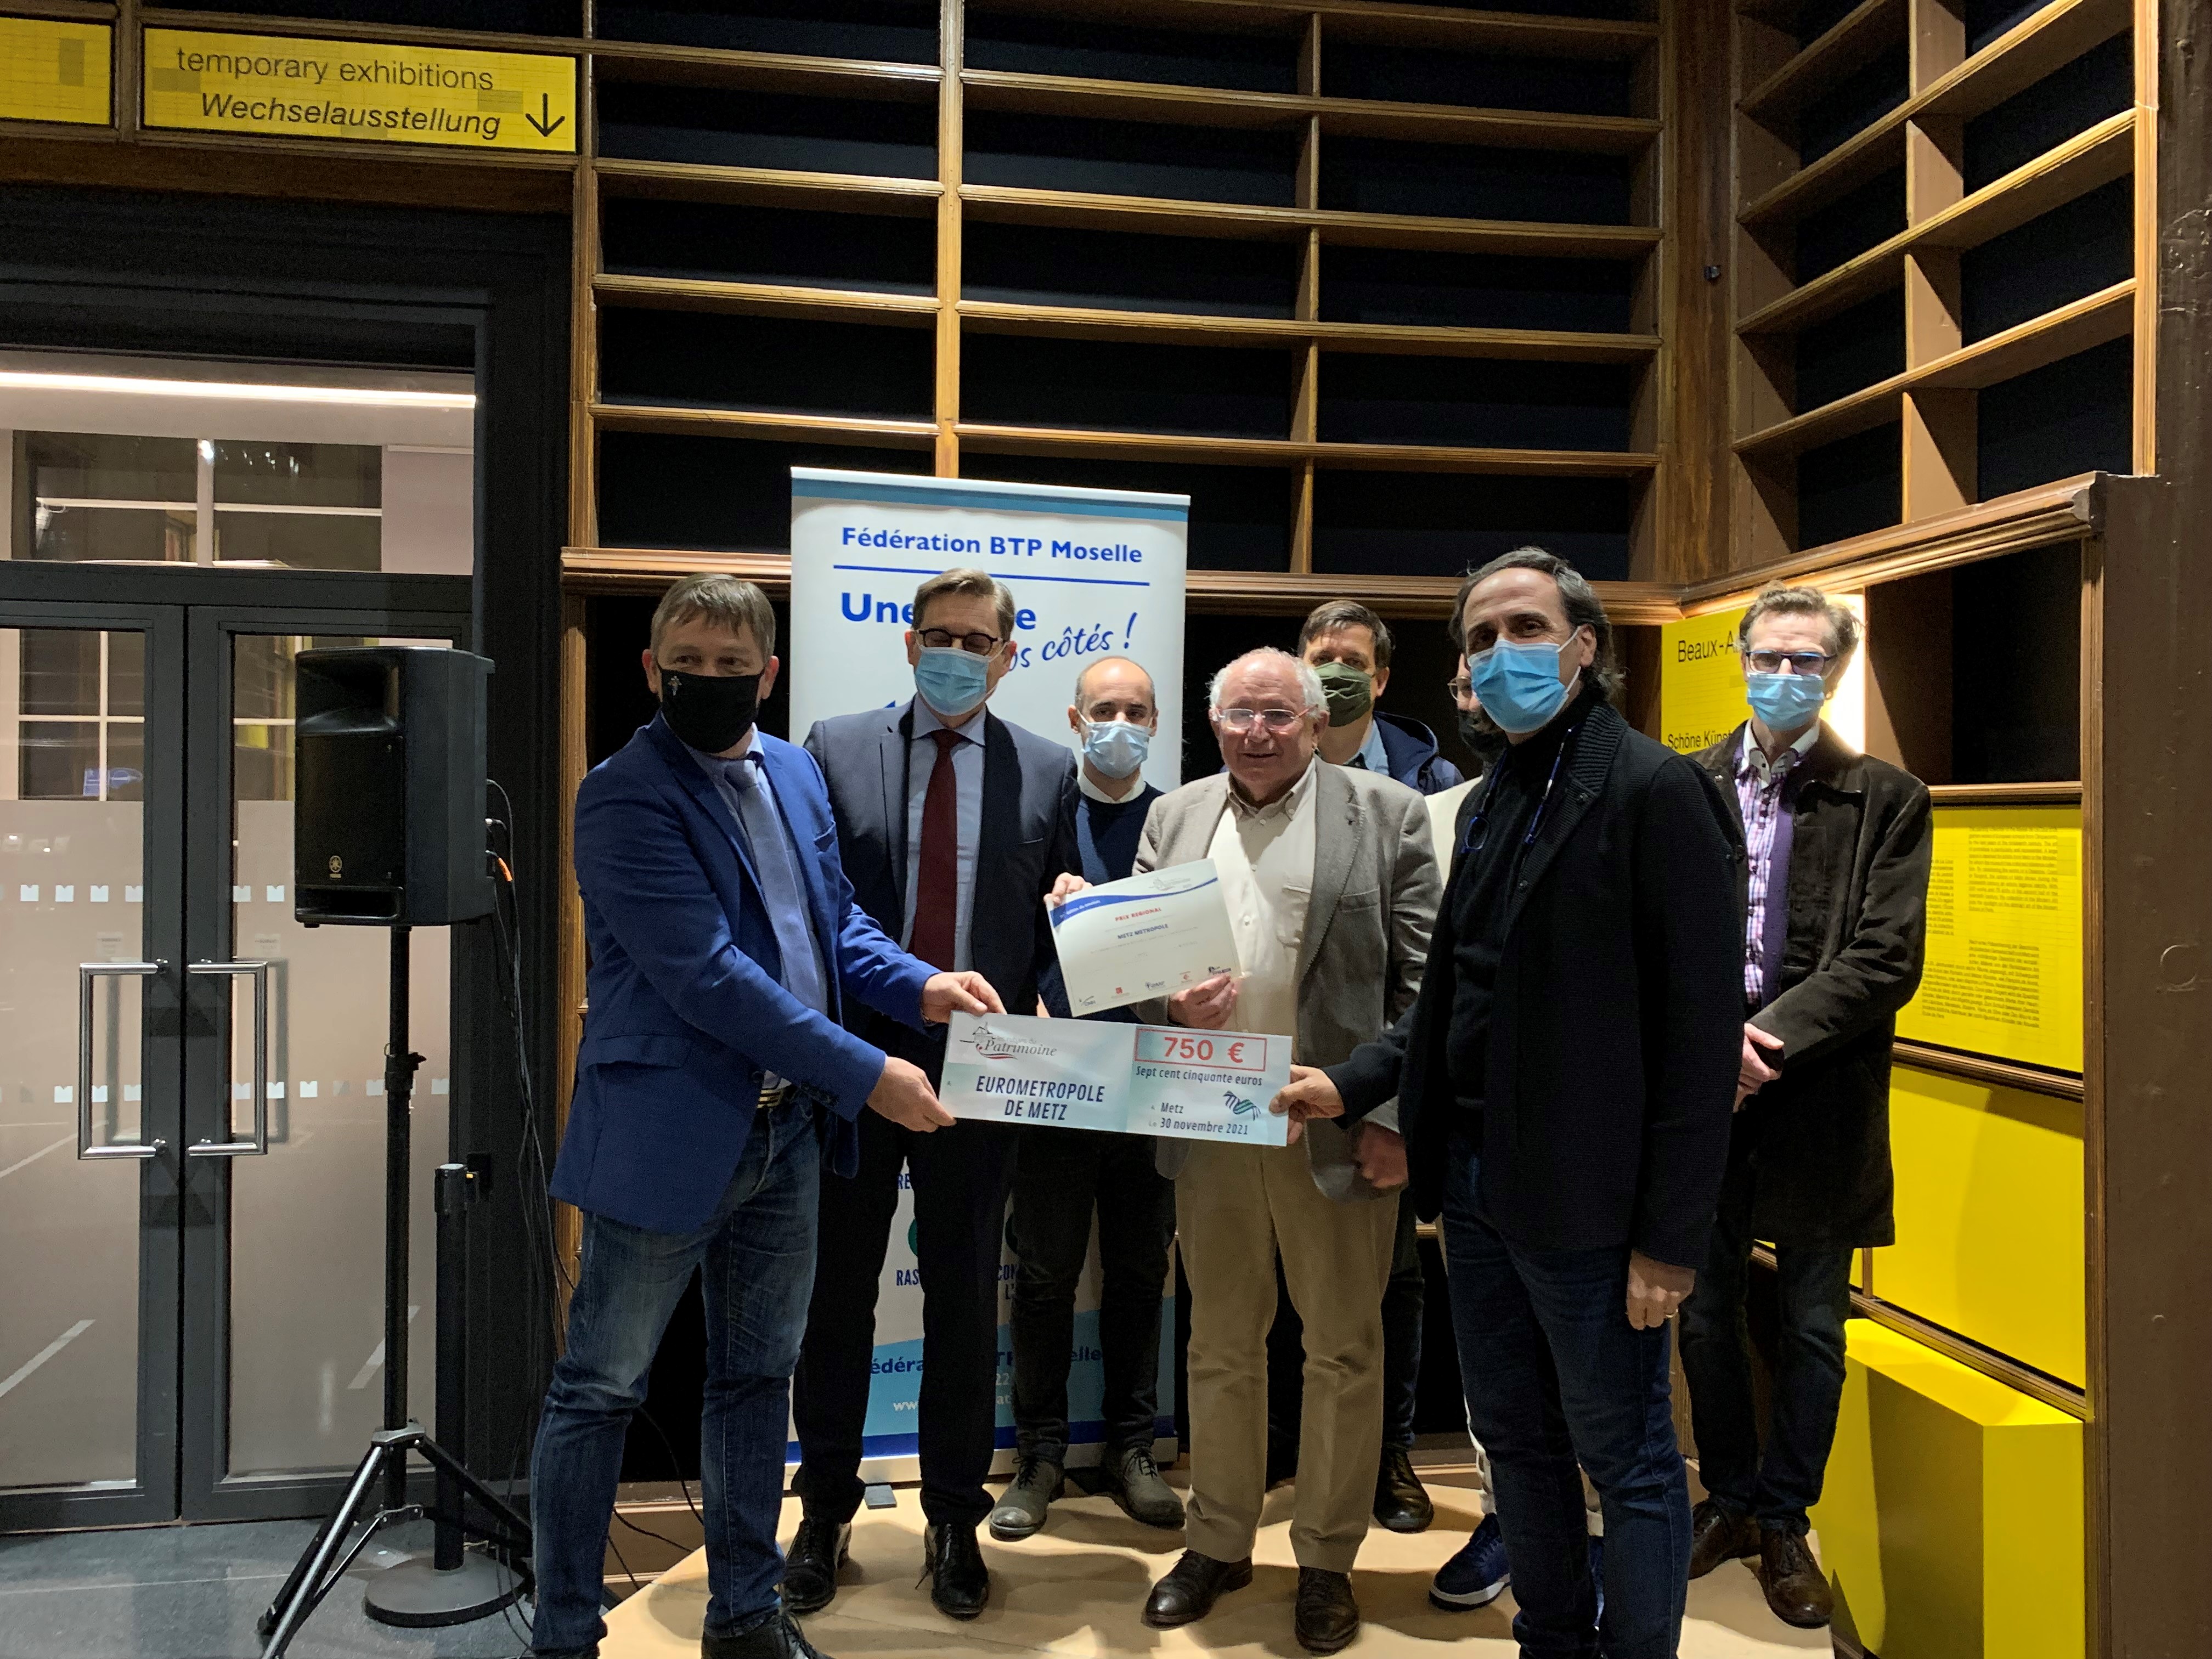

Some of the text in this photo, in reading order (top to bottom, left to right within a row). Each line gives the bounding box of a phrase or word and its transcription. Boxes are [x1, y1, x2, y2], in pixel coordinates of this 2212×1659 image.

[177, 46, 494, 92] temporary exhibitions
[201, 92, 500, 140] Wechselausstellung
[842, 527, 1142, 563] Fédération BTP Moselle
[1042, 623, 1115, 662] côtés
[1678, 630, 1734, 662] Beaux-A
[1668, 732, 1701, 749] Schöne
[985, 1039, 1057, 1057] Patrimoine
[1164, 1036, 1245, 1063] 750 €
[976, 1075, 1105, 1103] EUROMETROPOLE
[1136, 1065, 1262, 1086] Sept cent cinquante euros
[1005, 1099, 1068, 1120] DE METZ
[1160, 1102, 1184, 1114] Metz
[1160, 1117, 1171, 1128] 30
[1173, 1120, 1223, 1133] novembre
[1226, 1123, 1248, 1135] 2021
